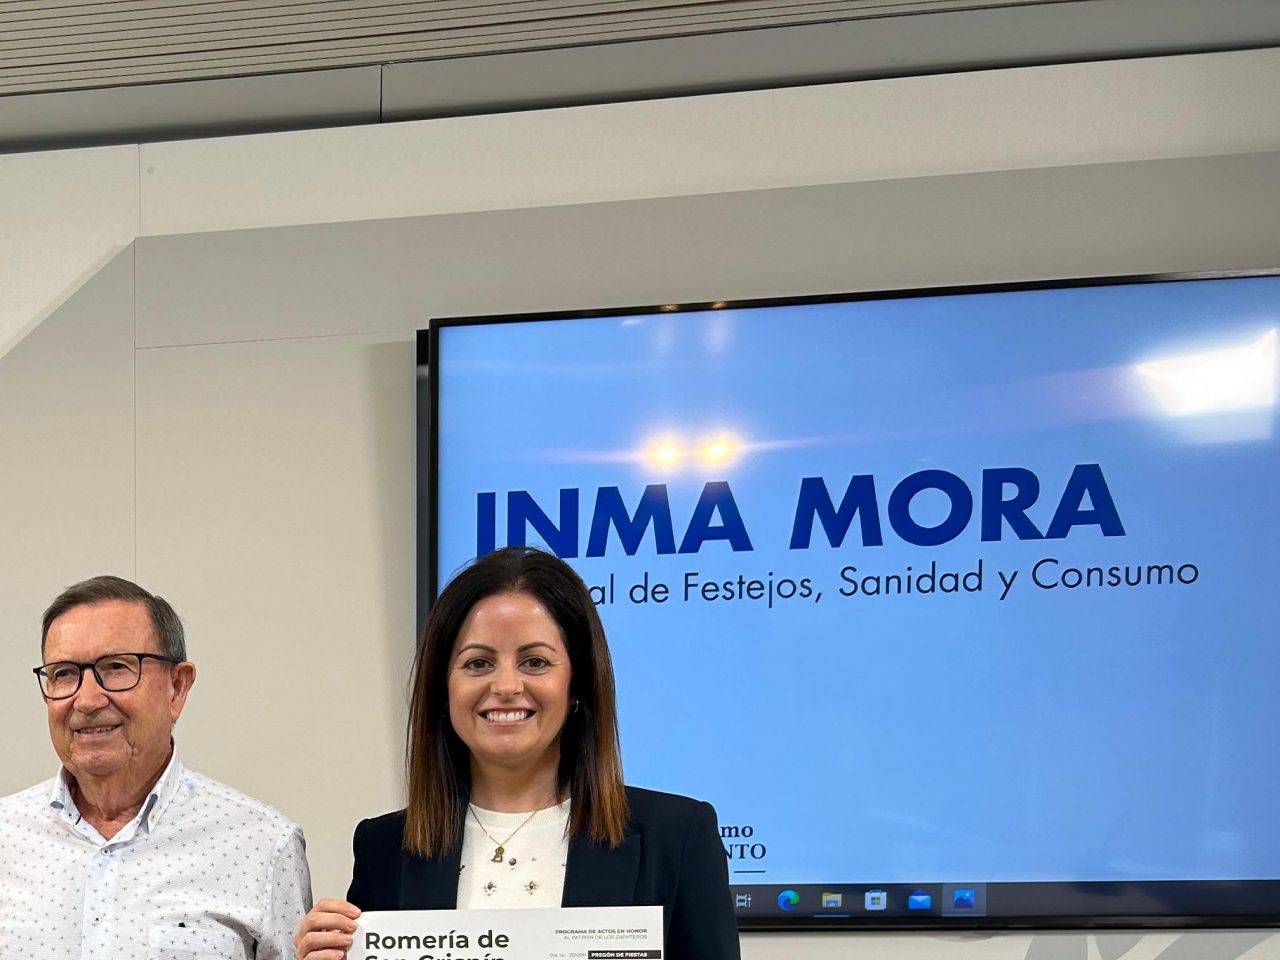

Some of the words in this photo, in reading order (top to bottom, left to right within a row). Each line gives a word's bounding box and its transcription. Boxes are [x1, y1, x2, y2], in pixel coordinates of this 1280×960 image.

[477, 481, 754, 559] INMA
[789, 464, 1126, 550] MORA
[629, 572, 669, 603] de
[684, 571, 822, 608] Festejos,
[839, 559, 983, 597] Sanidad
[998, 570, 1019, 600] y
[1032, 558, 1199, 589] Consumo
[365, 930, 469, 949] Romería
[477, 930, 509, 948] de
